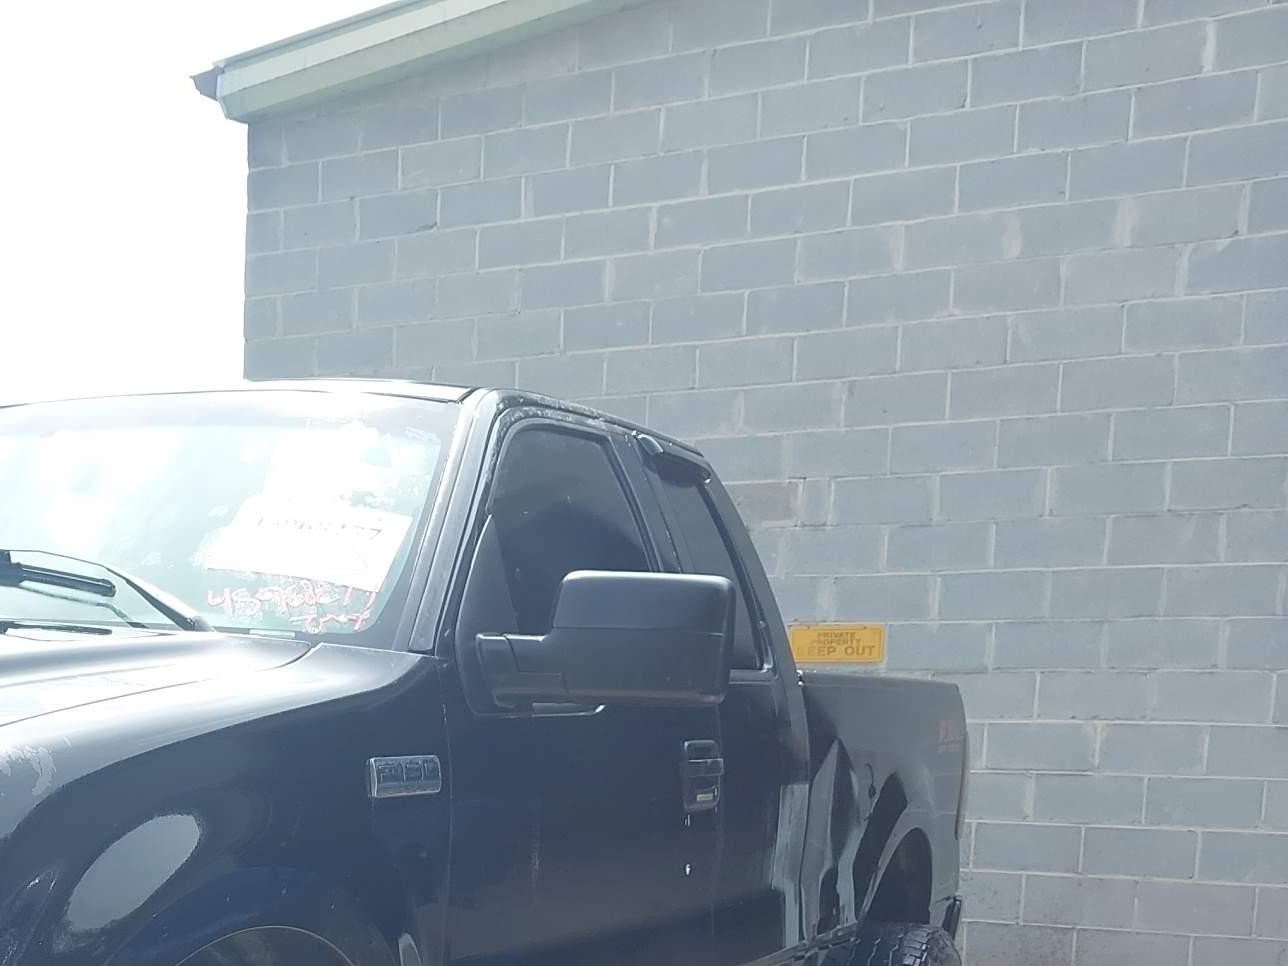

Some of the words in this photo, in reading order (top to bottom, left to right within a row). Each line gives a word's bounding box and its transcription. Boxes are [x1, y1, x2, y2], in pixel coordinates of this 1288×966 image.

[817, 631, 856, 639] PRIVATE
[810, 638, 862, 646] PROPERTY
[798, 645, 837, 657] EEP
[844, 645, 876, 657] OUT
